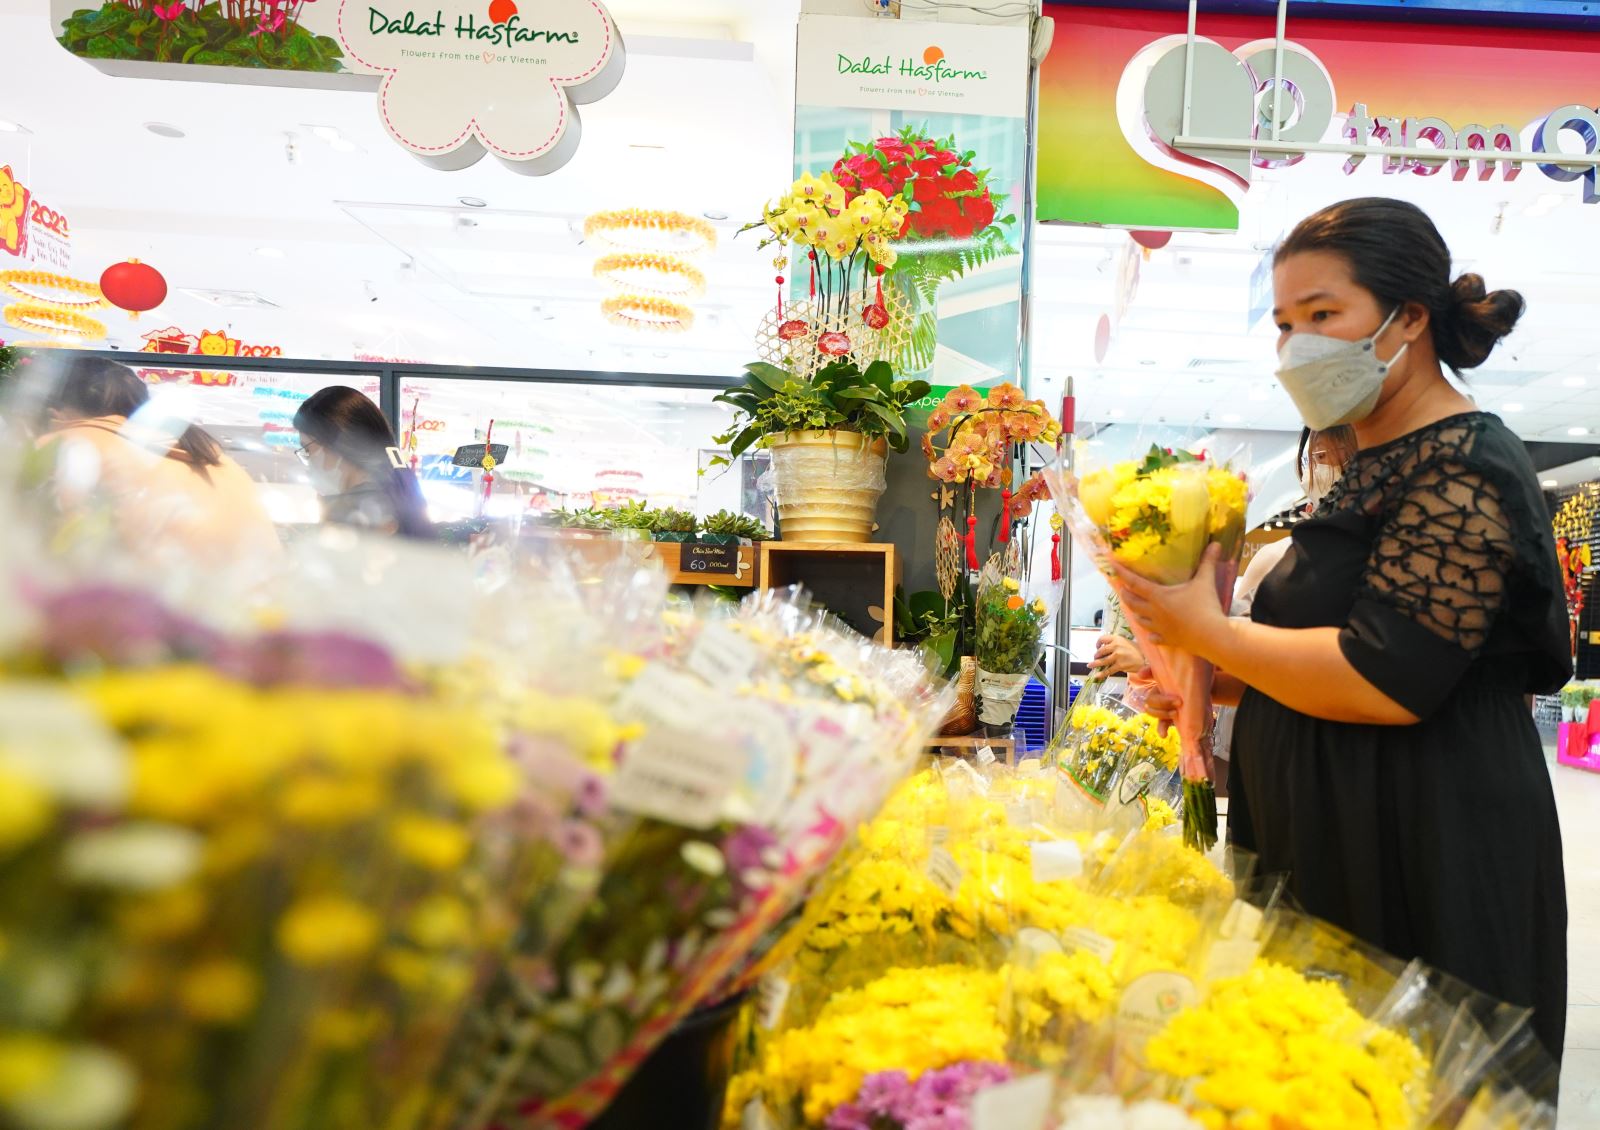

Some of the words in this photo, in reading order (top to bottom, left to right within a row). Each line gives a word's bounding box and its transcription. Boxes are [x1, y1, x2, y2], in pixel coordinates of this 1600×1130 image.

[369, 7, 446, 36] Dalat
[401, 49, 436, 59] Flowers
[439, 51, 461, 60] from
[465, 53, 480, 61] the
[496, 55, 506, 63] of
[510, 55, 547, 65] Vietnam
[838, 53, 892, 74] Dalat
[899, 58, 987, 82] Hasfarm
[859, 86, 885, 94] Flowers
[937, 90, 965, 98] Vietnam
[31, 200, 69, 238] 2023
[242, 345, 281, 357] 2023
[690, 560, 707, 570] 60
